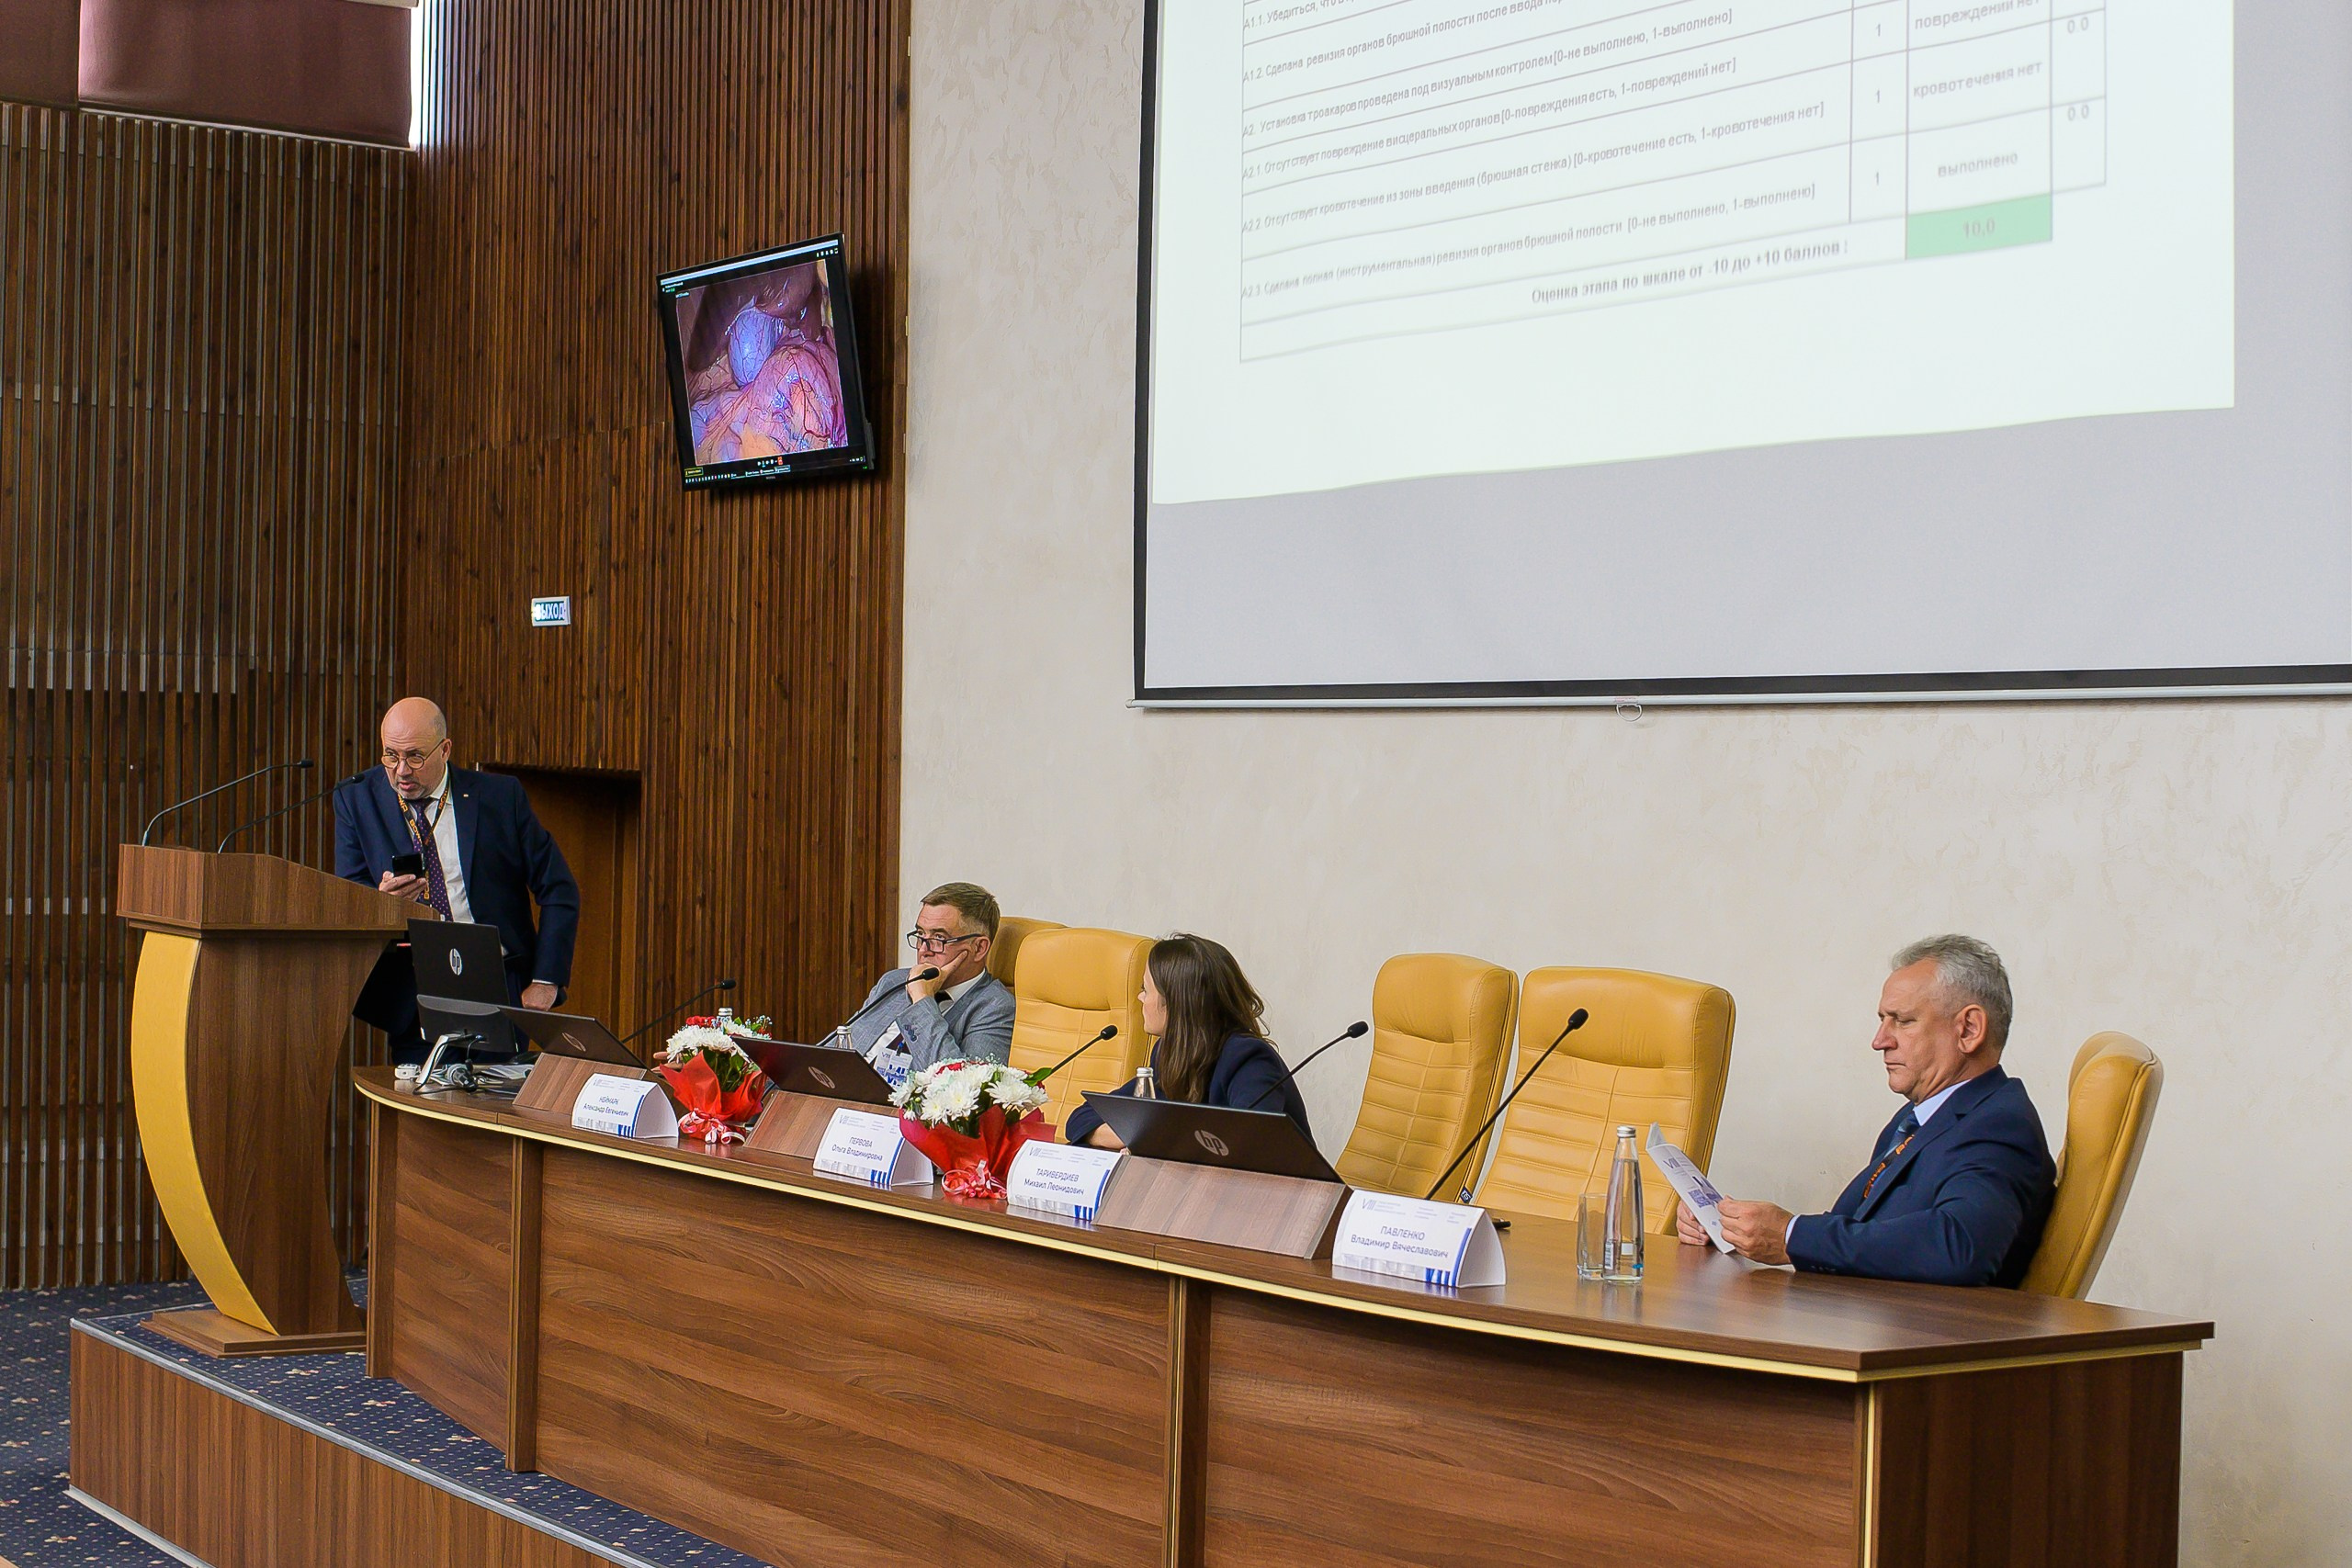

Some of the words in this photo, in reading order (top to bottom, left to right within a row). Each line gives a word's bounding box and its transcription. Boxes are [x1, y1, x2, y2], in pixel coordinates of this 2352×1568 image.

[1265, 59, 1304, 77] Сделана
[1306, 51, 1345, 68] ревизия
[1346, 38, 1385, 57] органов
[1385, 23, 1430, 47] брюшной
[1432, 14, 1475, 34] полости
[1476, 6, 1508, 23] после
[1875, 23, 1882, 38] 1
[1260, 112, 1306, 133] Установка
[1357, 89, 1409, 111] проведена
[1411, 83, 1430, 98] под
[1430, 64, 1494, 94] визуальным
[1583, 29, 1649, 57] выполнено,
[1652, 8, 1733, 39] 1-выполнено]
[1913, 67, 2014, 98] кровотечения
[2017, 61, 2043, 76] нет
[1875, 89, 1881, 103] 1
[1264, 152, 1319, 175] Отсутствует
[1320, 138, 1385, 160] повреждение
[1457, 112, 1499, 133] органов
[1621, 64, 1709, 96] 1-повреждений
[1710, 57, 1736, 75] нет]
[1386, 192, 1397, 203] из
[1399, 186, 1423, 201] зоны
[1425, 175, 1475, 196] введения
[1476, 165, 1529, 187] (брюшная
[1531, 154, 1572, 175] стенка)
[1701, 110, 1795, 141] 1-кровотечения
[1797, 101, 1825, 120] нет]
[1938, 152, 2018, 178] выполнено
[1874, 171, 1880, 186] 1
[1436, 244, 1479, 265] ревизия
[1480, 237, 1524, 258] органов
[1524, 228, 1574, 250] брюшной
[1576, 221, 1623, 242] полости
[1658, 203, 1729, 226] выполнено,
[1733, 183, 1816, 211] 1-выполнено]
[1532, 284, 1578, 304] Оценка
[1582, 278, 1619, 297] этапа
[1623, 276, 1639, 289] по
[1643, 268, 1687, 287] шкале
[1690, 265, 1703, 279] от
[1732, 256, 1751, 276] до
[1783, 242, 1840, 262] баллов
[450, 948, 462, 976] hp
[831, 1144, 846, 1154] Ольга
[846, 1146, 883, 1162] Владимировна
[849, 1136, 873, 1147] ПЕРВОВА
[1197, 1130, 1226, 1156] hp
[1023, 1178, 1046, 1189] Михаил
[1047, 1181, 1084, 1195] Леонидович
[1036, 1168, 1079, 1182] ТАРИВЕРДИЕВ
[1380, 1225, 1426, 1240] ПАВЛЕНКО
[1351, 1235, 1390, 1249] Владимир
[1392, 1241, 1449, 1258] Вячеславович
